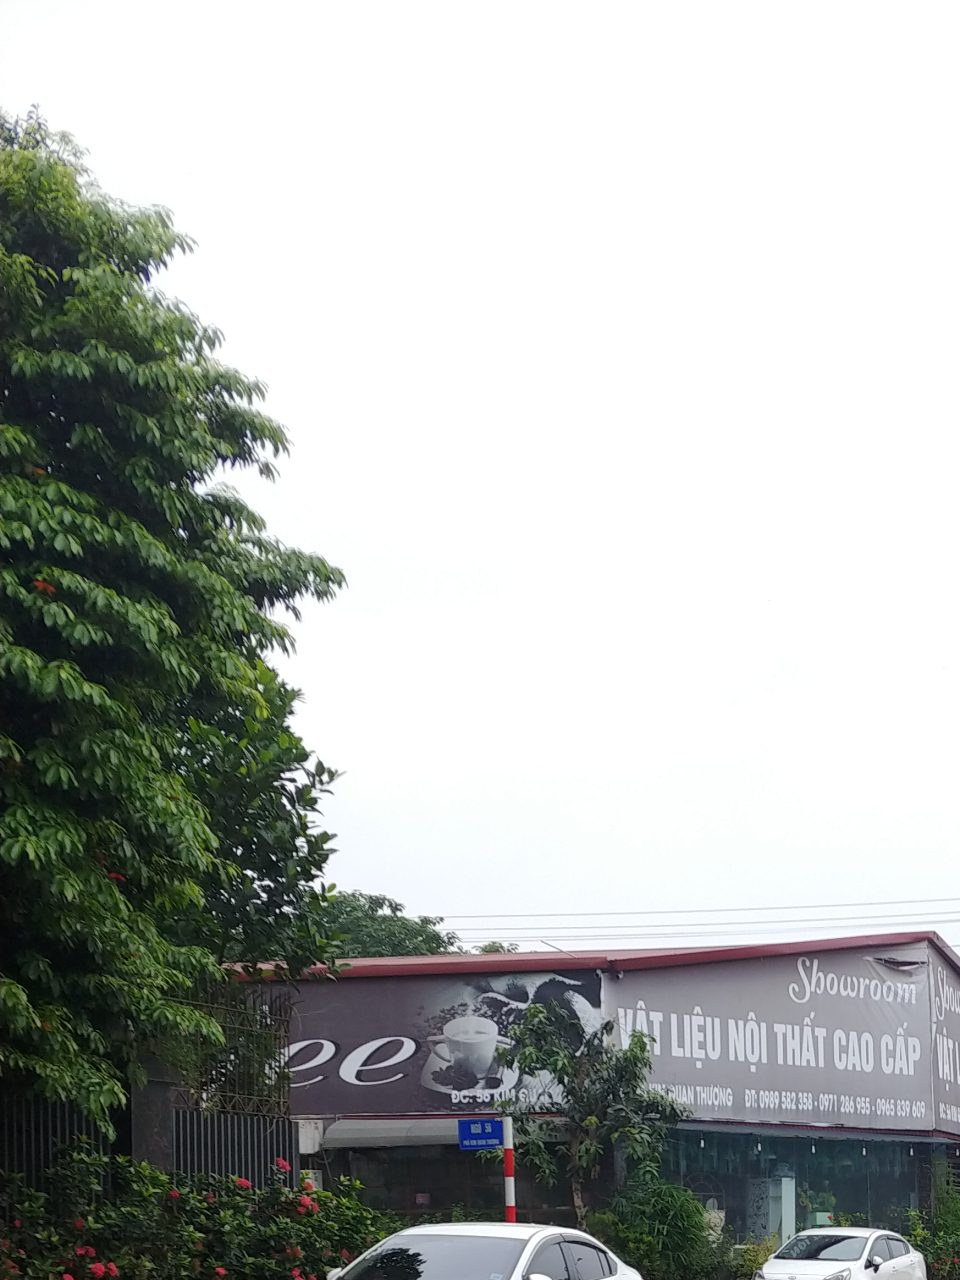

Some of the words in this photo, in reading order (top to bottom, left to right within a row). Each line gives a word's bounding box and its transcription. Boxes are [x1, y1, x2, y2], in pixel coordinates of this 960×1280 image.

[788, 956, 917, 1004] Showroom
[670, 1005, 721, 1069] LIỆU
[728, 1011, 768, 1073] NỘI
[773, 1011, 827, 1068] THẤT
[833, 1028, 875, 1073] CAO
[880, 1021, 921, 1076] CẤP
[936, 1026, 954, 1091] VẬT
[696, 1084, 733, 1111] THƯỢNG
[744, 1088, 757, 1108] ĐT:
[759, 1090, 779, 1109] 0989
[781, 1092, 796, 1110] 582
[798, 1093, 813, 1111] 358
[819, 1093, 837, 1111] 0971
[840, 1096, 855, 1114] 286
[856, 1098, 870, 1115] 955
[876, 1098, 895, 1116] 0965
[896, 1099, 910, 1117] 839
[912, 1100, 926, 1118] 609
